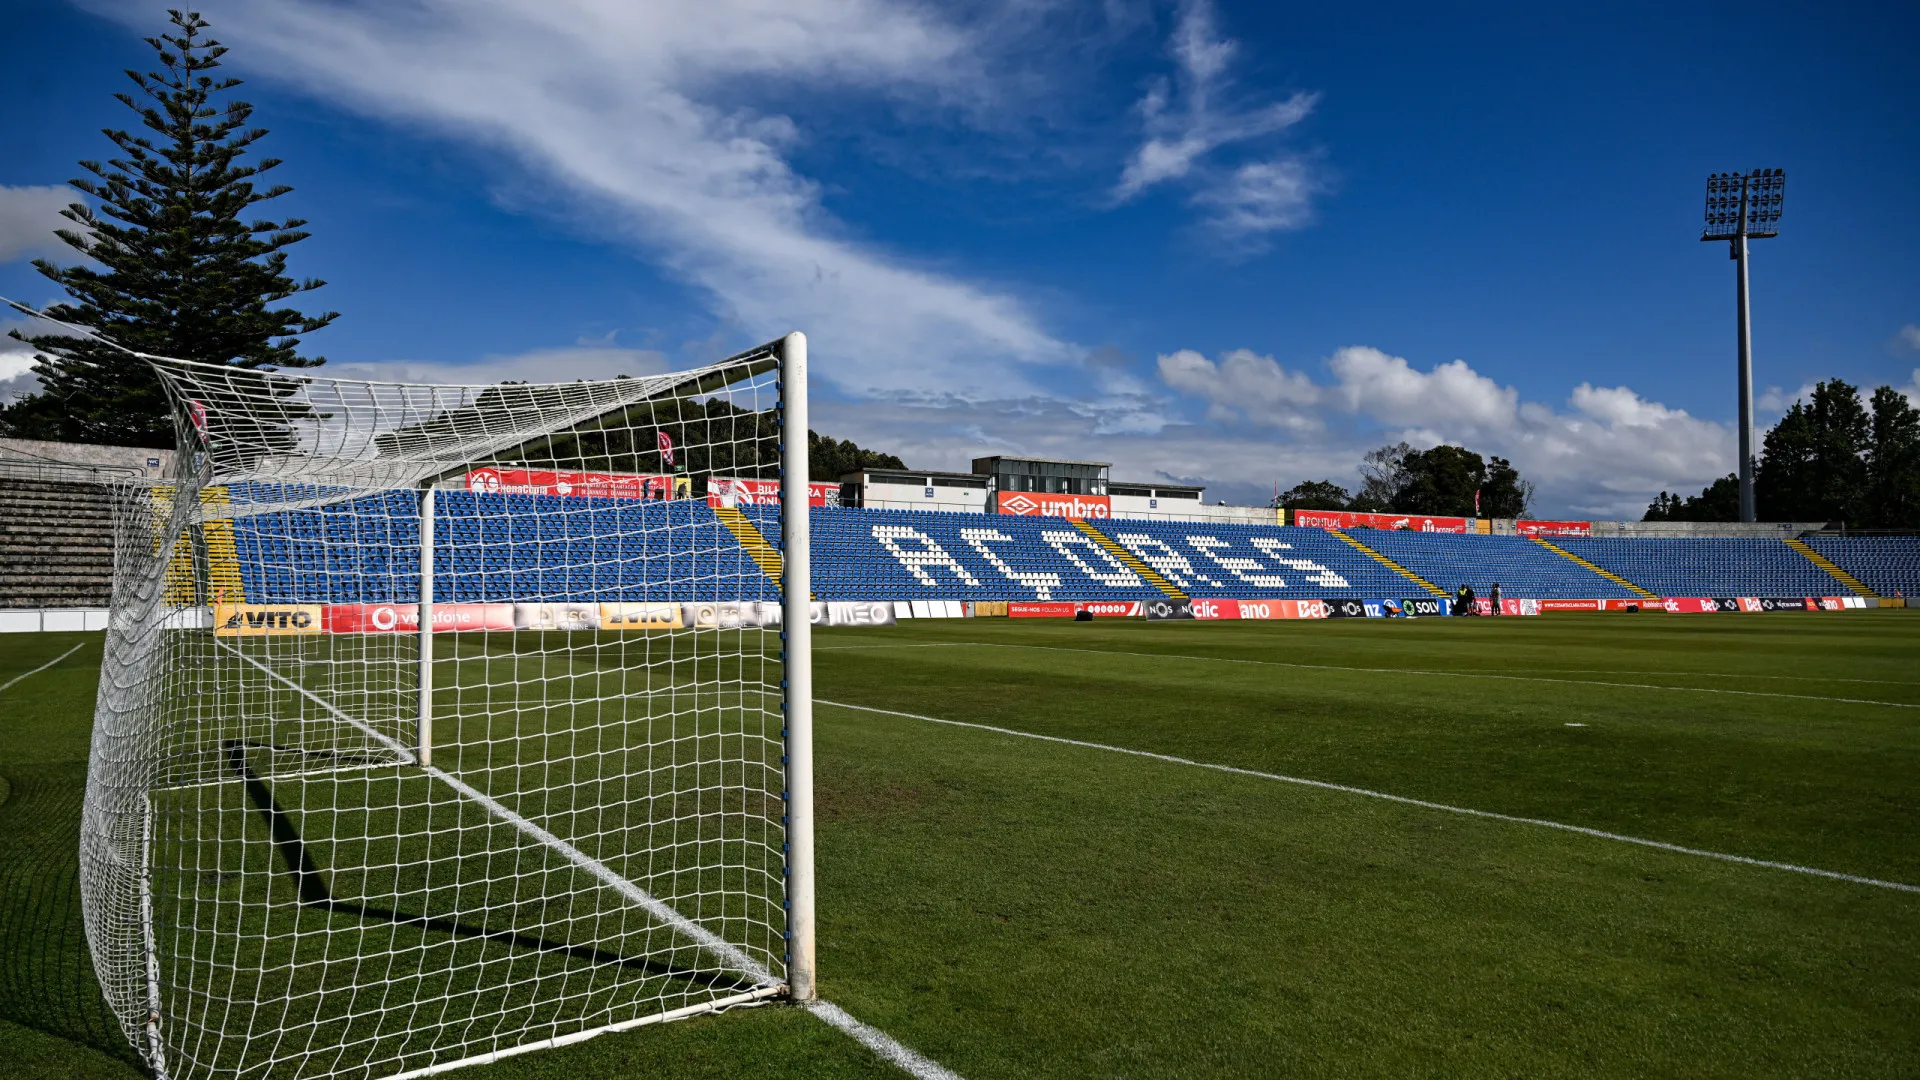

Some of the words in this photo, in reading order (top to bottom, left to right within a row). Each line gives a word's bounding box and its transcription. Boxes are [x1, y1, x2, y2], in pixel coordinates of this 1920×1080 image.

[1041, 498, 1108, 519] umbro
[1306, 517, 1341, 527] PONTUAL
[1149, 602, 1173, 617] NOS
[1193, 601, 1219, 618] clic
[1240, 604, 1270, 618] ano
[1297, 600, 1327, 618] Bet
[1341, 602, 1361, 616] NOS
[225, 611, 312, 629] AVITO
[401, 610, 471, 624] voafone
